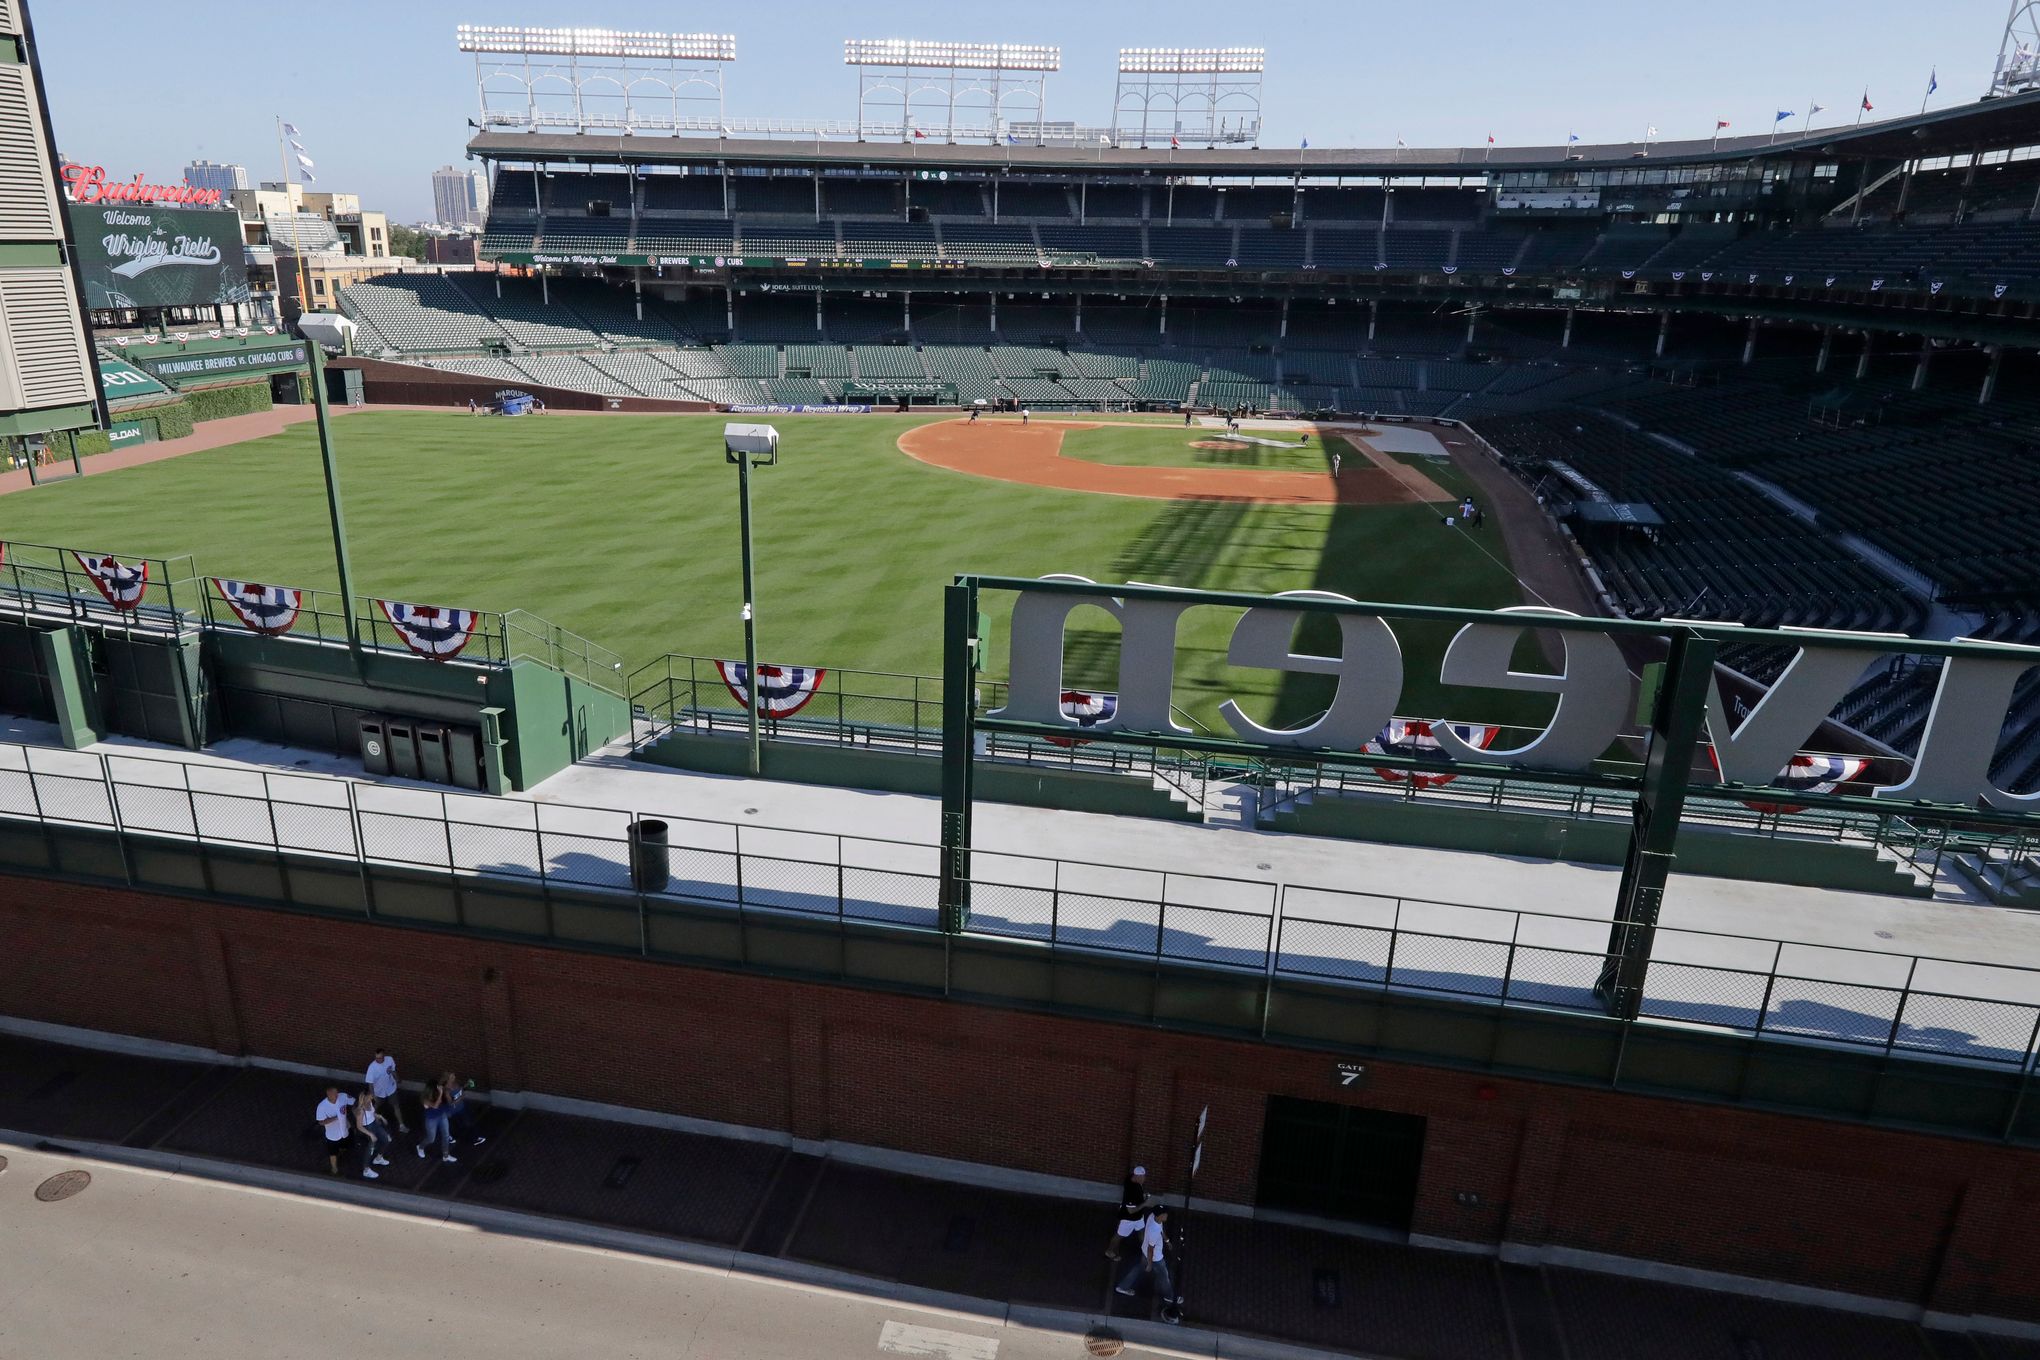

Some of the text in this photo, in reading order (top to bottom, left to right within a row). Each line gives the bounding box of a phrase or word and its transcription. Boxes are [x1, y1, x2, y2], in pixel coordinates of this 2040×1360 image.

[60, 164, 222, 204] Budweiser
[102, 211, 151, 226] Welcome
[102, 233, 213, 262] Wrigley Field
[532, 255, 617, 265] Welcome to Wrigley Field
[660, 257, 689, 265] BREWERS
[727, 258, 743, 266] CUBS
[158, 360, 204, 375] MILWAUKEE
[204, 356, 237, 370] BREWERS
[248, 352, 276, 365] CHICAGO
[277, 351, 294, 361] CUBS
[102, 371, 148, 388] en
[731, 405, 788, 413] Reynolds Wrap
[802, 405, 859, 413] Reynolds Wrap
[1337, 1063, 1365, 1072] GATE
[1341, 1071, 1360, 1085] 7
